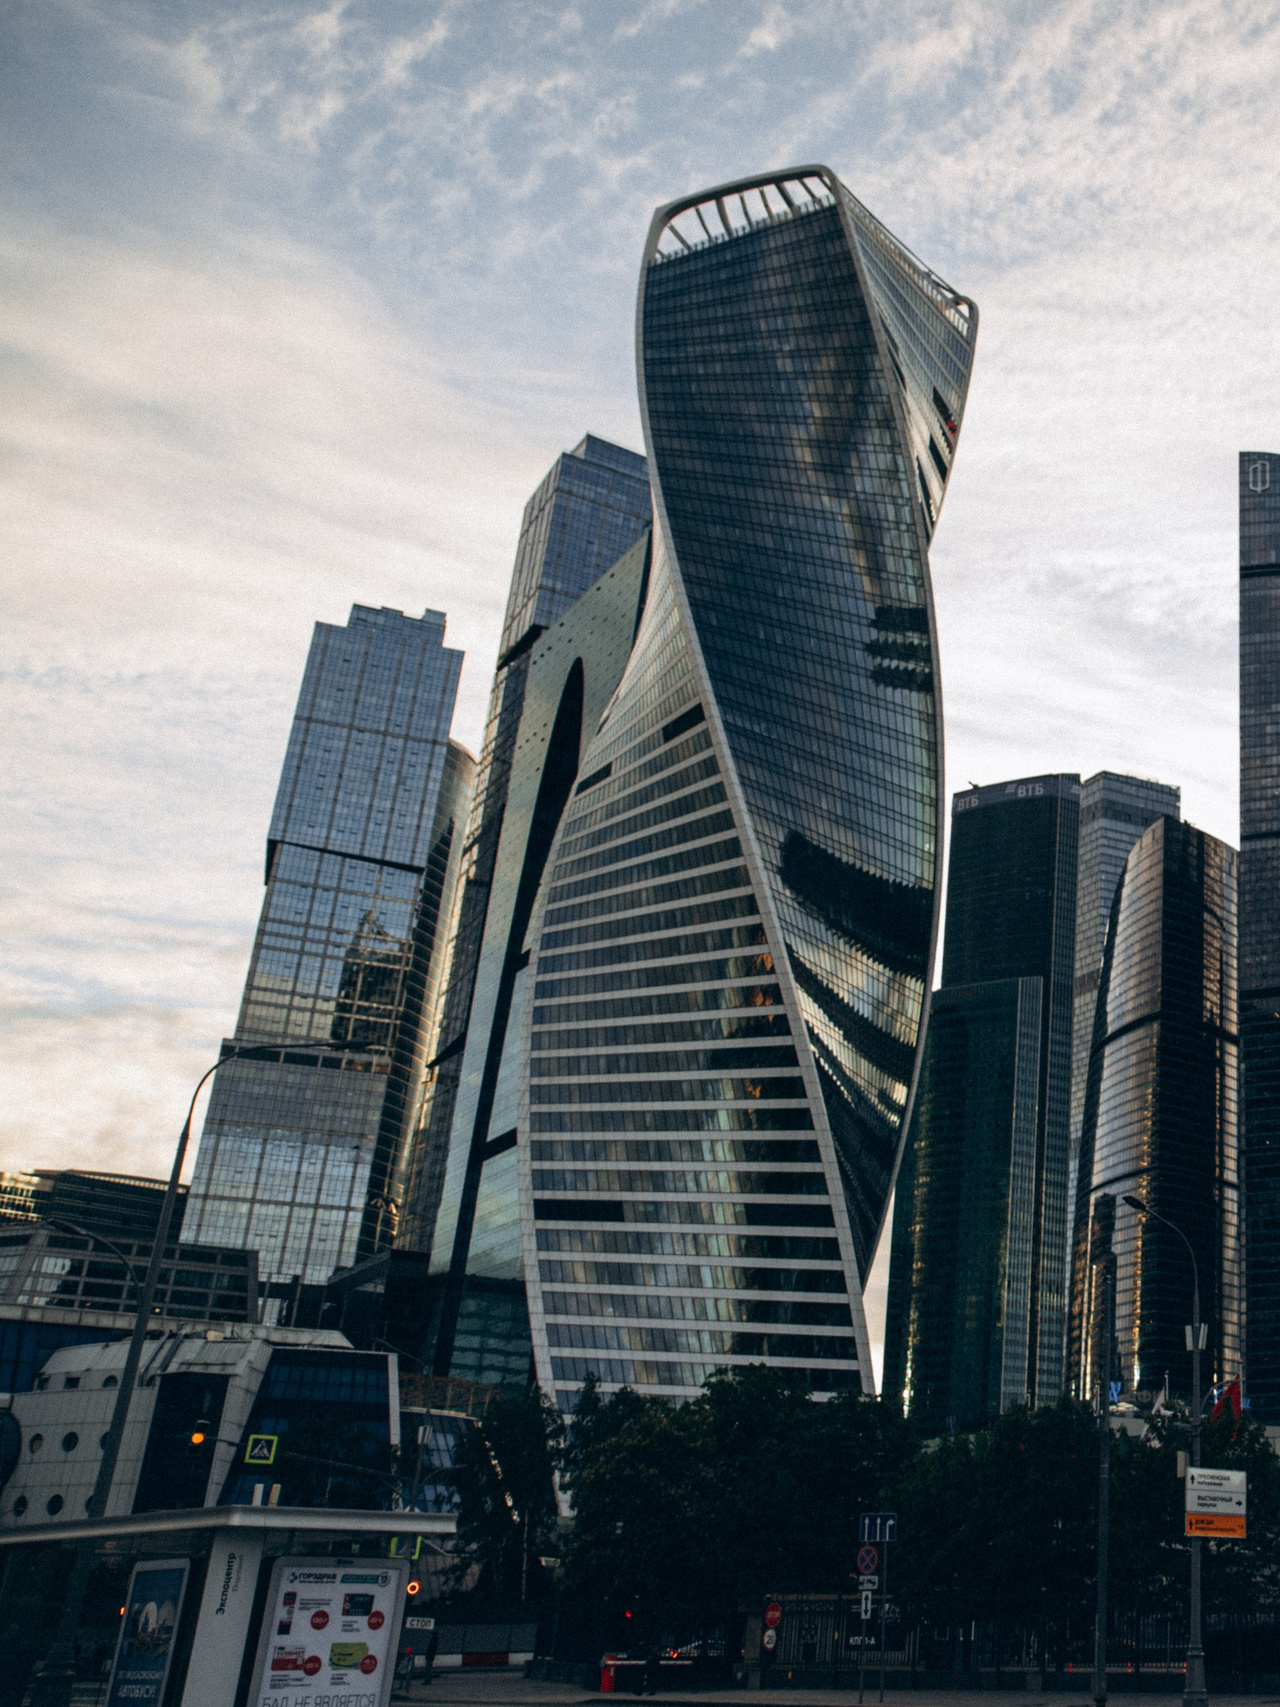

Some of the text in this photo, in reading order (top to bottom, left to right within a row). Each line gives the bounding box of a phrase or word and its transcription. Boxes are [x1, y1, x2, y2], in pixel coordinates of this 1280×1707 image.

[1017, 783, 1044, 798] ВТБ
[957, 795, 979, 811] ВТБ
[299, 1572, 337, 1580] ГОРЗДРАВ
[215, 1552, 236, 1615] Экспоцентр
[767, 1610, 781, 1619] STOP
[409, 1618, 432, 1628] СТОП
